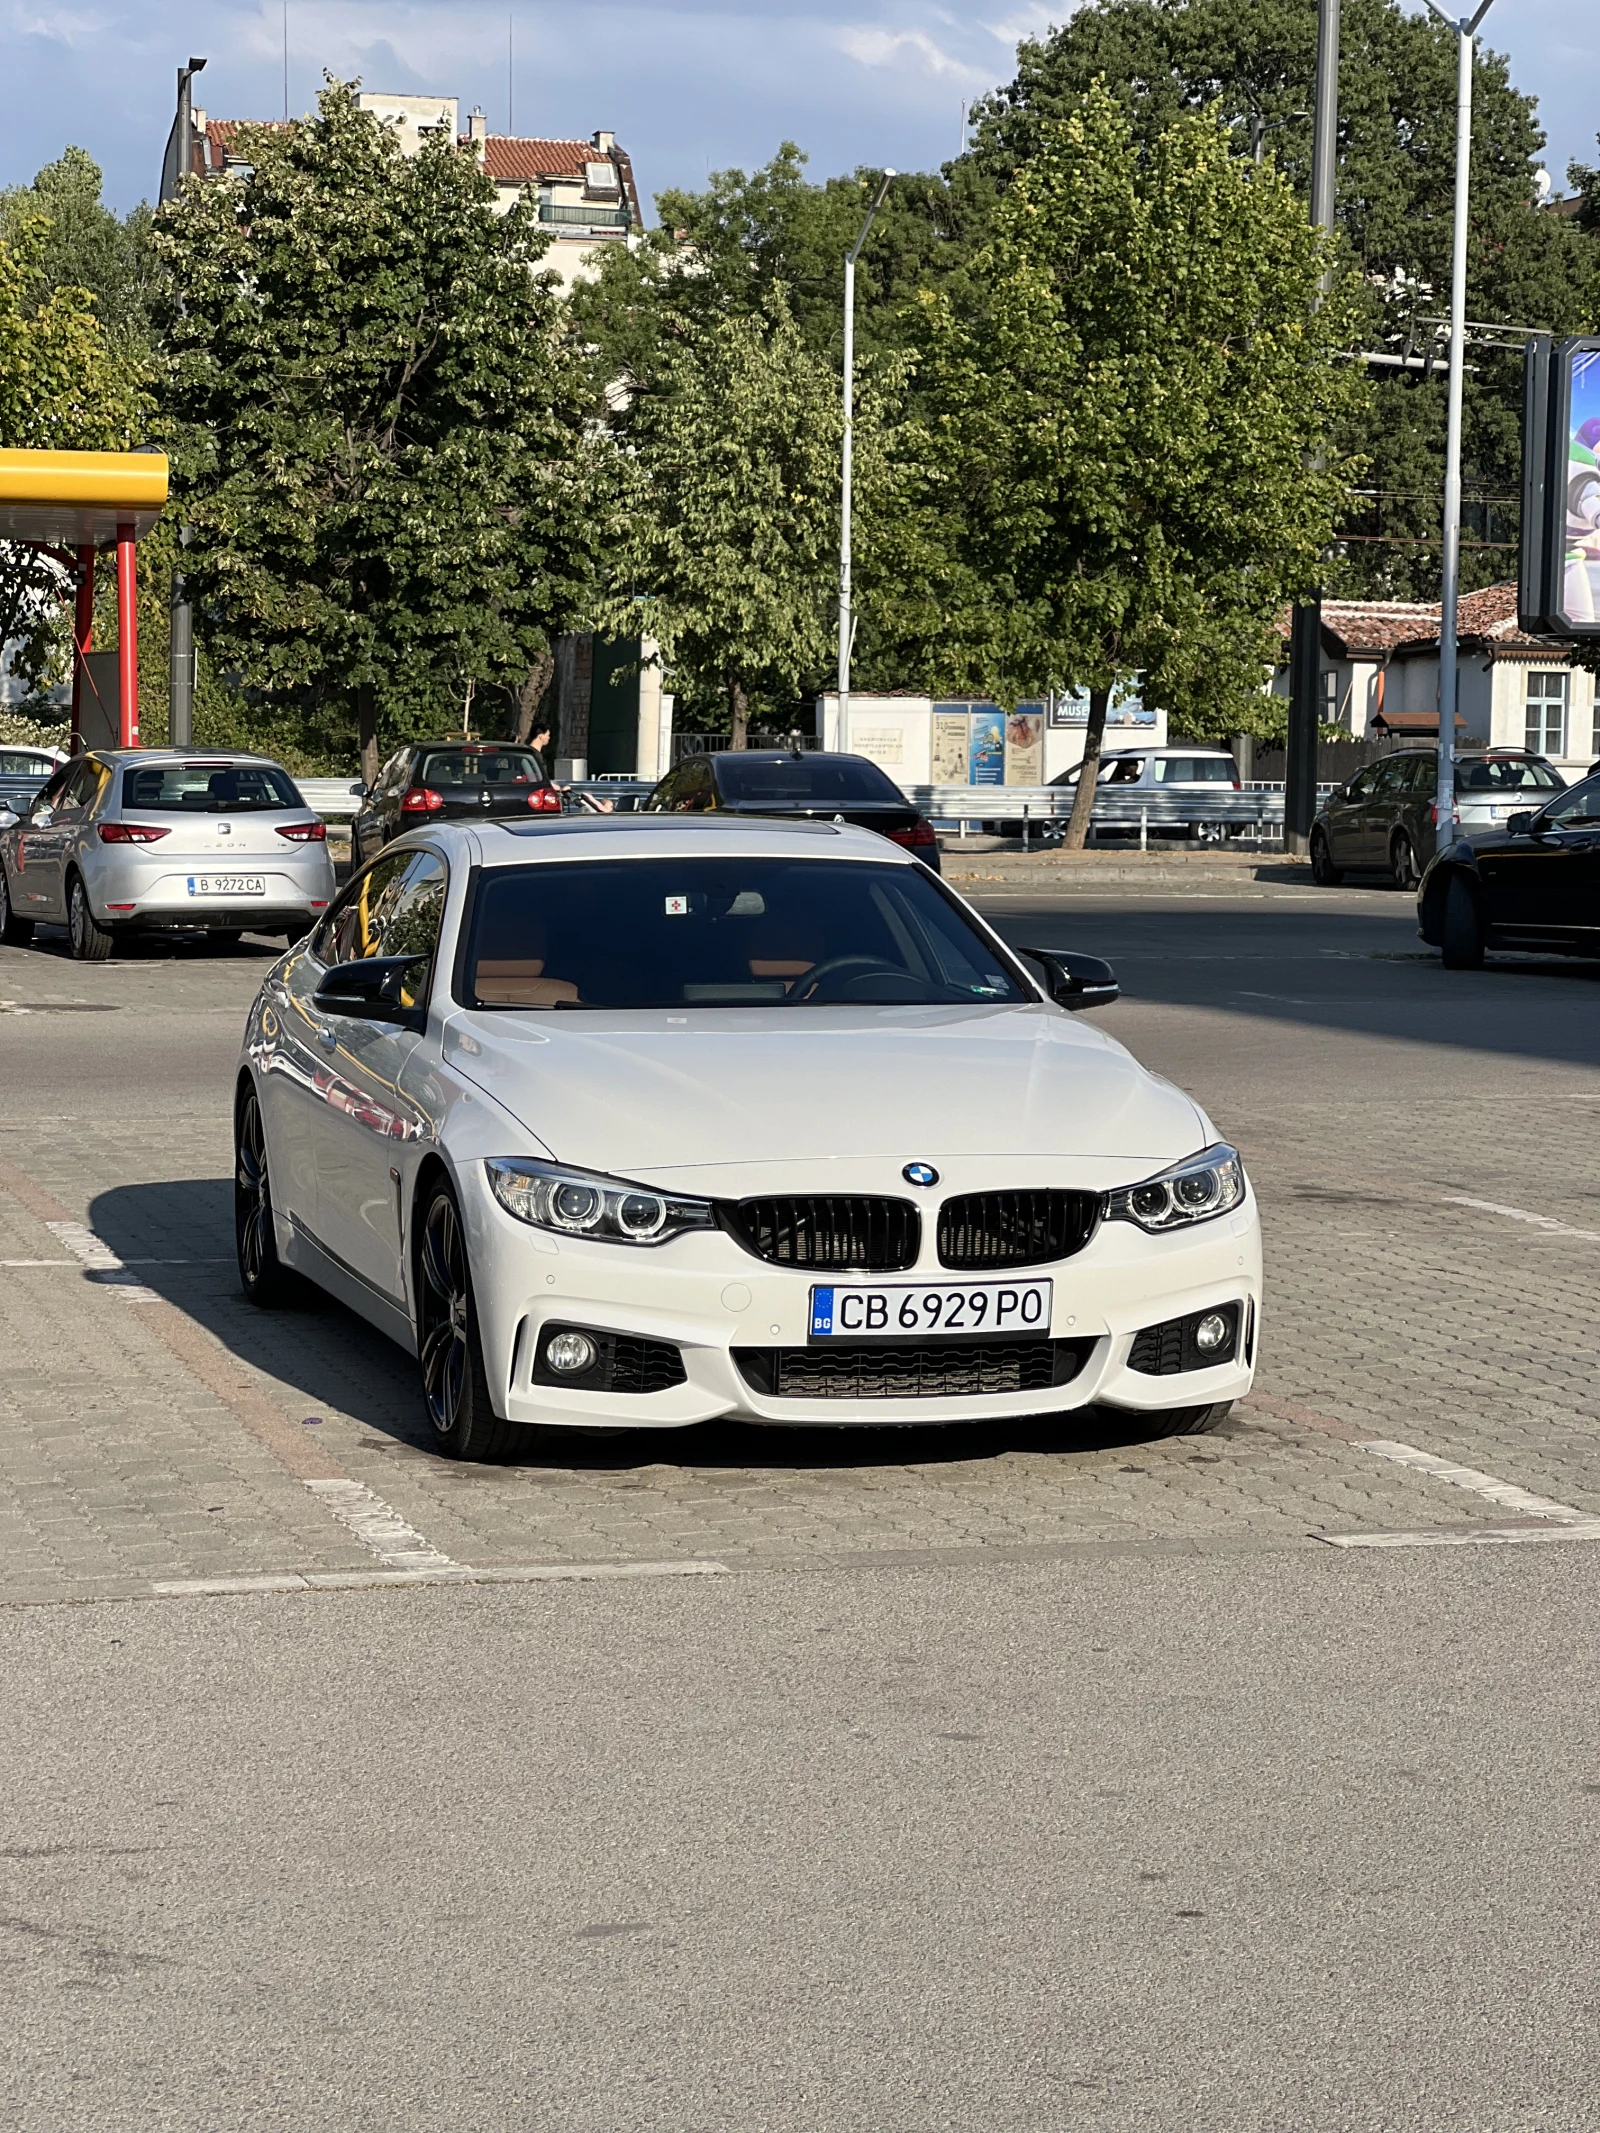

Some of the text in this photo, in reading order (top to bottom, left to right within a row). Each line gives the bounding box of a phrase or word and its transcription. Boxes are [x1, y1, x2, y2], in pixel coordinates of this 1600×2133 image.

[1057, 706, 1090, 716] MUSE
[200, 879, 209, 891] B
[214, 878, 245, 891] 9272
[840, 1294, 889, 1329] CB
[898, 1291, 988, 1329] 6929
[814, 1317, 831, 1329] BG
